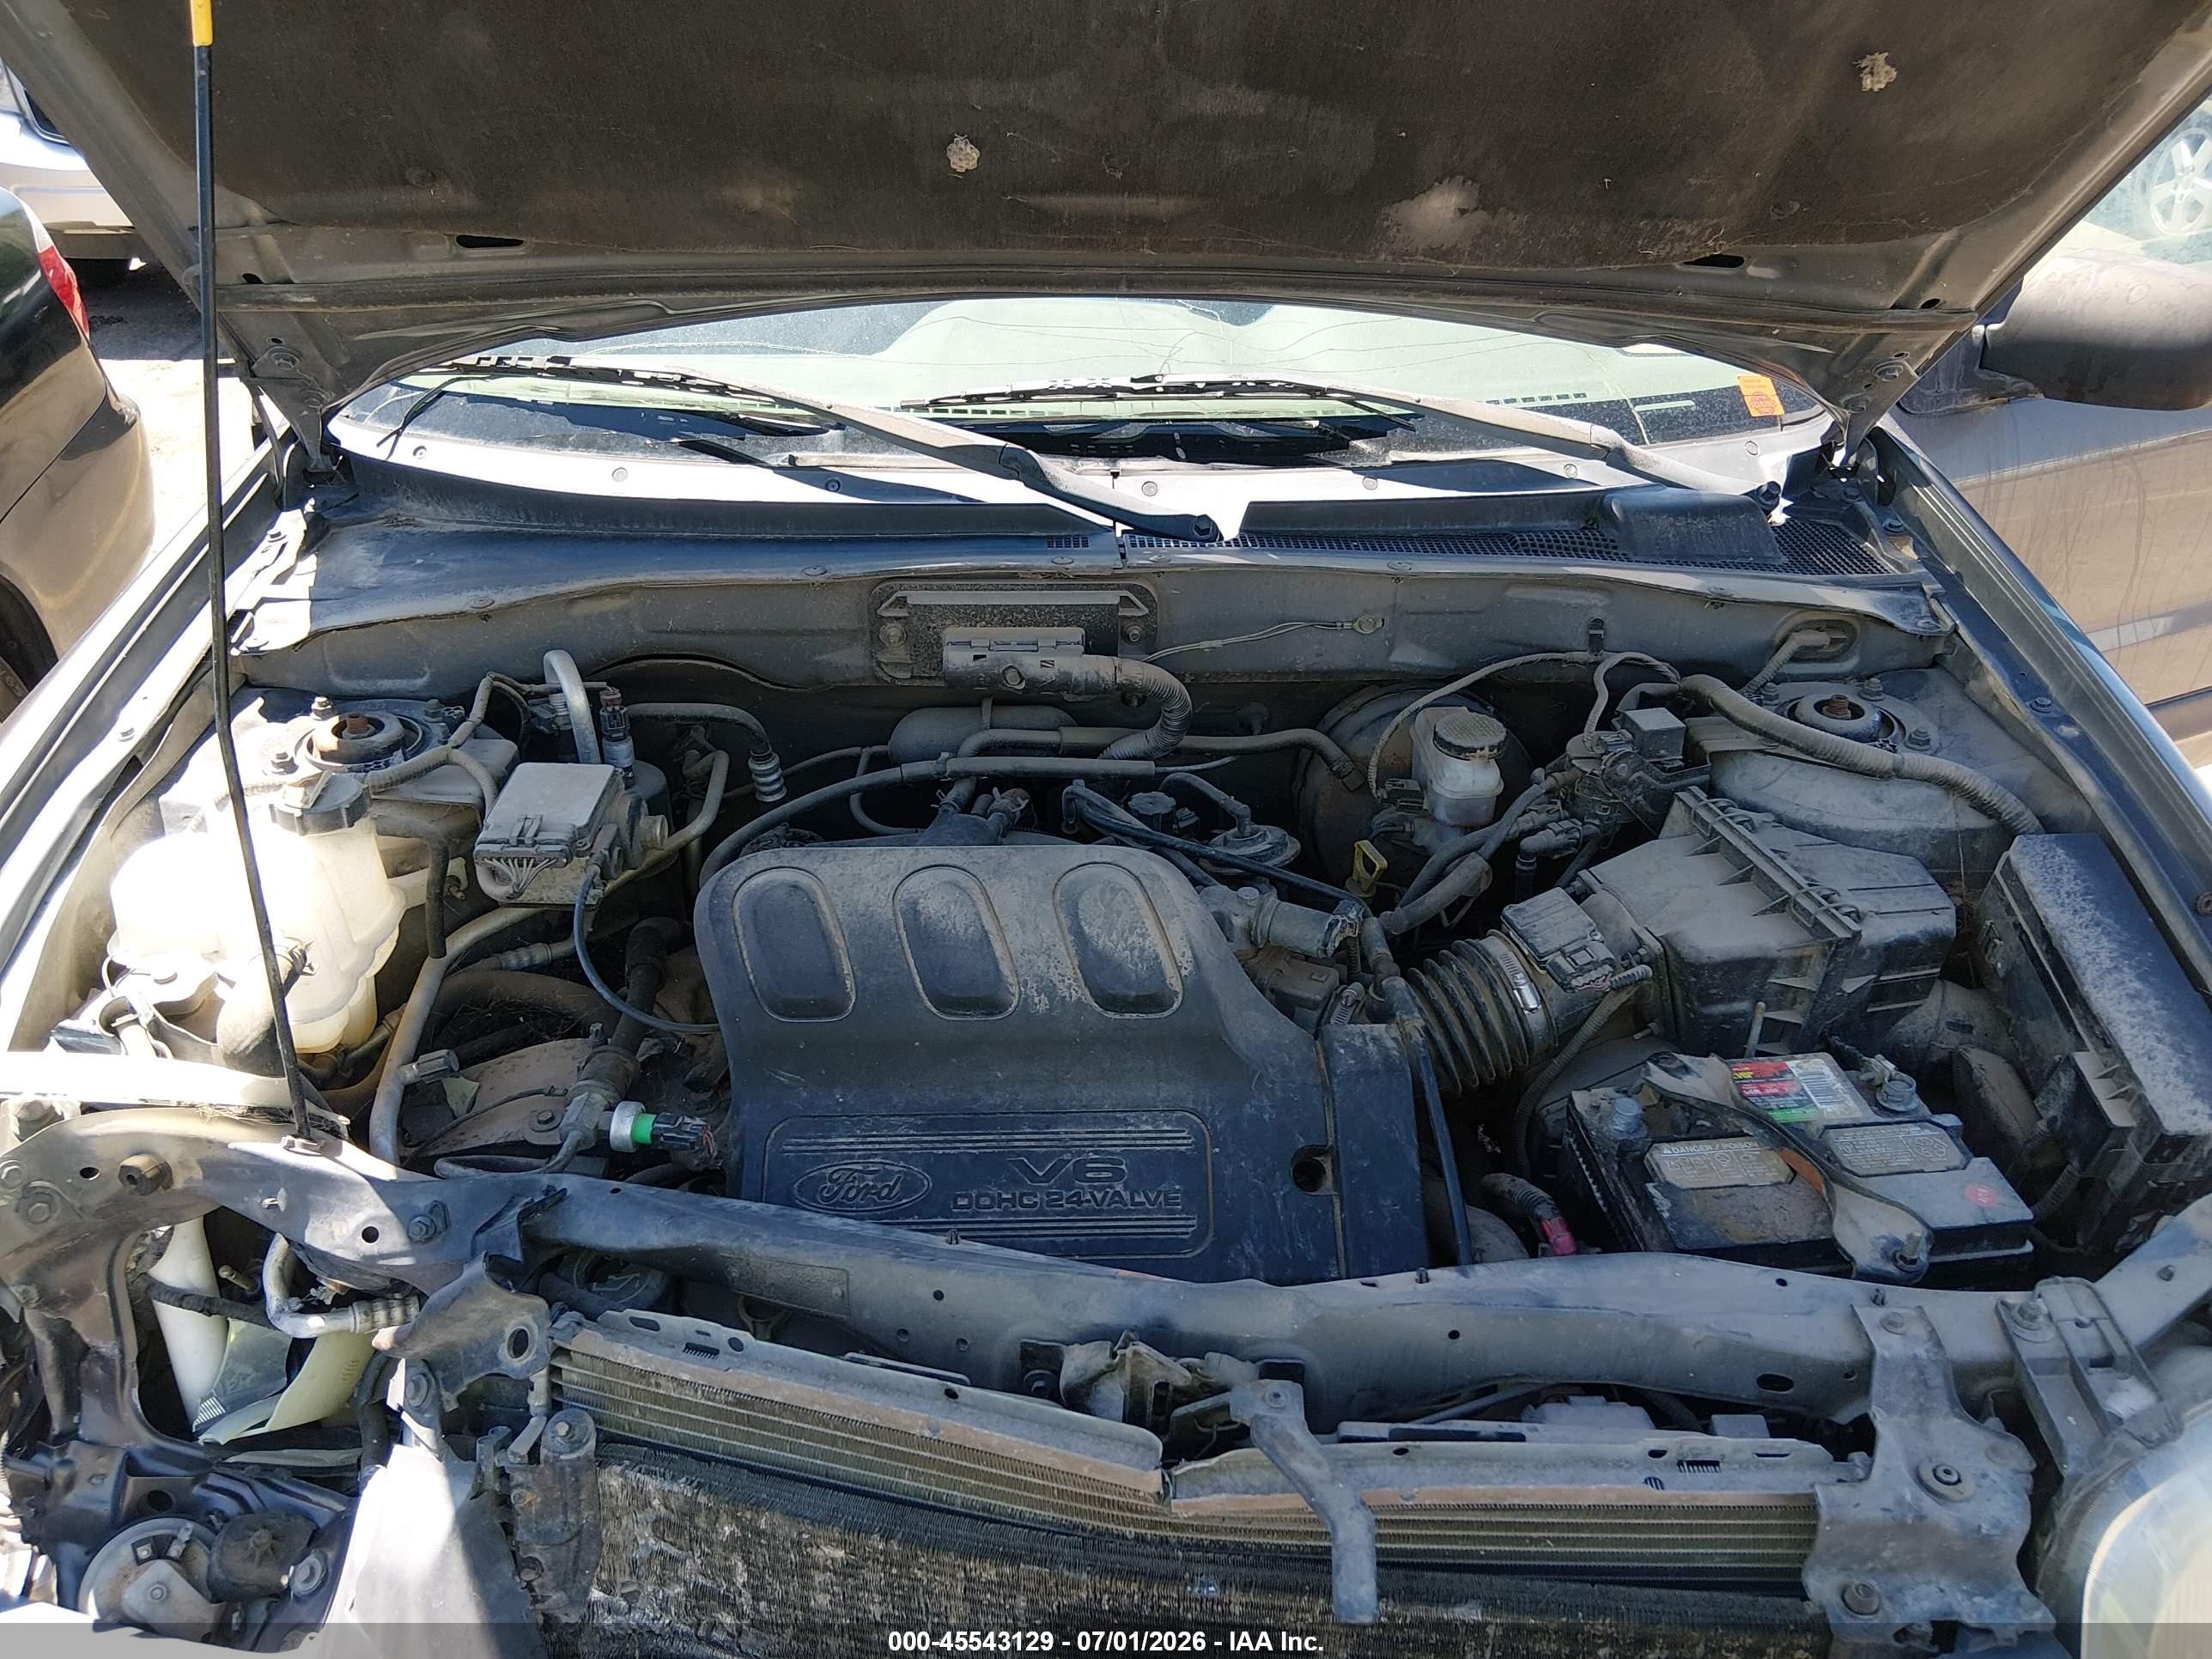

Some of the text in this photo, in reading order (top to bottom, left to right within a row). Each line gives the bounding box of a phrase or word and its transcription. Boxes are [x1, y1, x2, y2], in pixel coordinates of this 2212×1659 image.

[1672, 1144, 1712, 1154] DANGER
[1723, 1140, 1759, 1150] POISON
[1007, 1156, 1128, 1186] V6
[817, 1166, 903, 1204] Ford
[951, 1188, 1182, 1212] DOHC 24-VALVE
